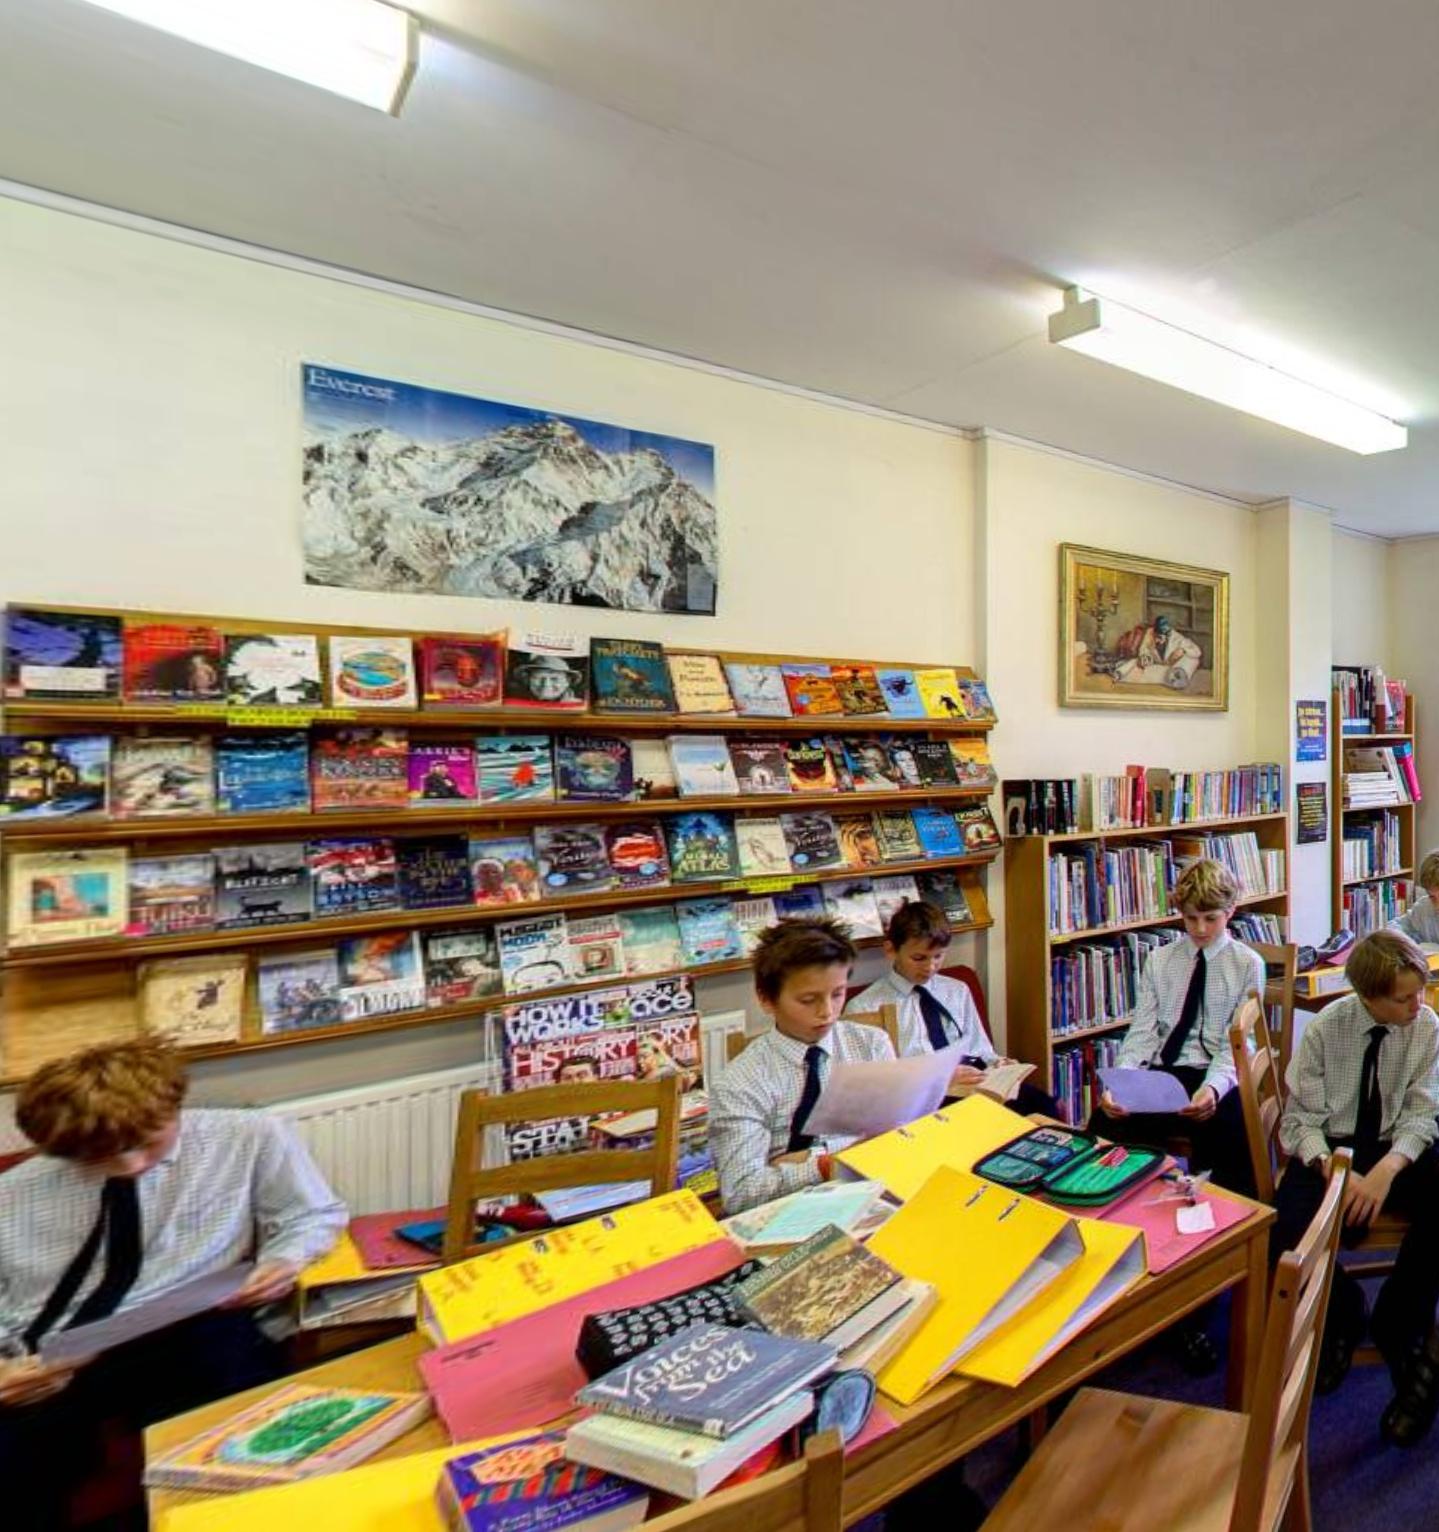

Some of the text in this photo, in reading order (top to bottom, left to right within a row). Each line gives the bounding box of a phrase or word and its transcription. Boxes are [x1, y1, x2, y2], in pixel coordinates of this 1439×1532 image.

[307, 367, 397, 401] Everest
[505, 998, 574, 1030] HOW
[507, 1012, 606, 1045] WORKS
[591, 1328, 729, 1396] Voices
[667, 1348, 757, 1401] Sea
[634, 1359, 699, 1406] from
